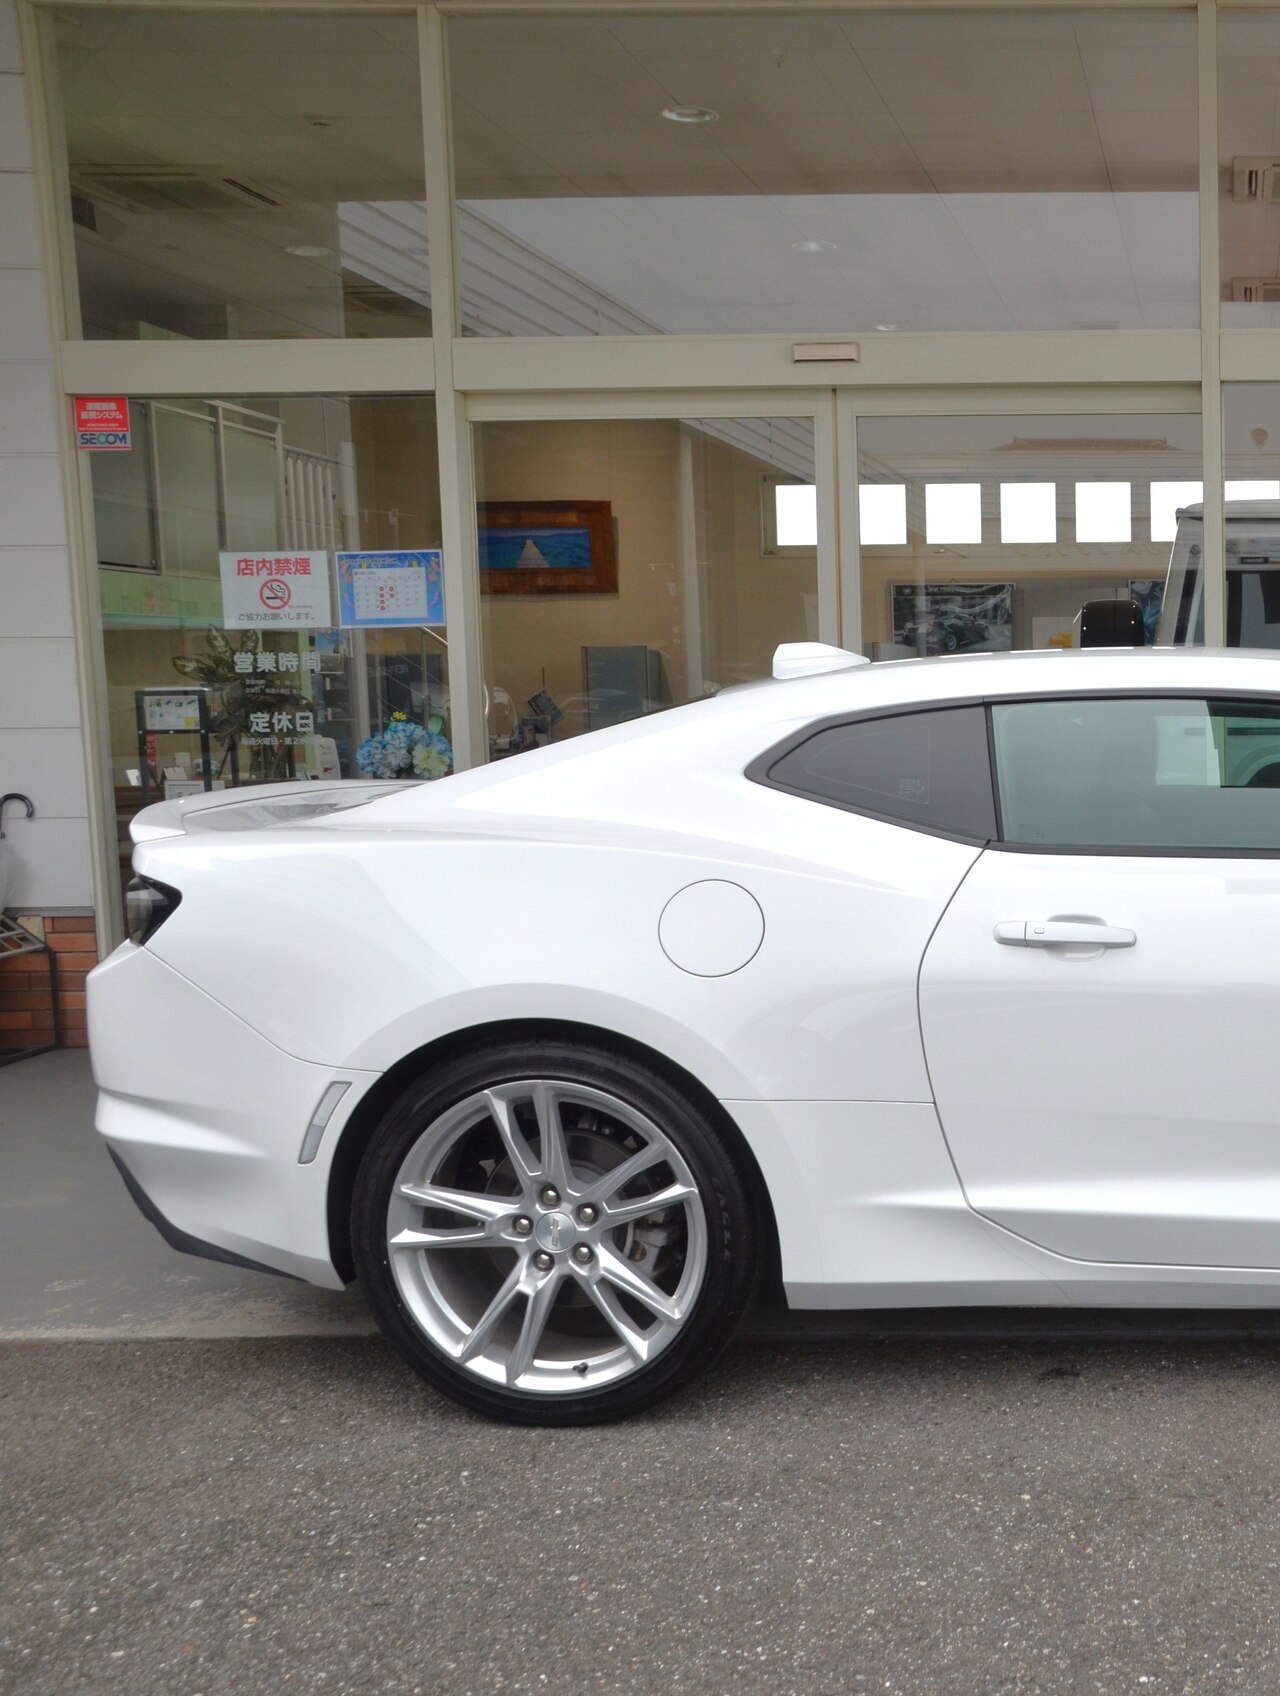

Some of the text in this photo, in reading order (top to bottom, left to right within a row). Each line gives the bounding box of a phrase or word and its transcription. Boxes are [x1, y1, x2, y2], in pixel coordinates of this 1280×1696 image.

[80, 433, 127, 445] SECOM
[236, 557, 312, 577] 店内禁煙
[233, 652, 321, 673] 営業時間
[249, 711, 315, 733] 定休日
